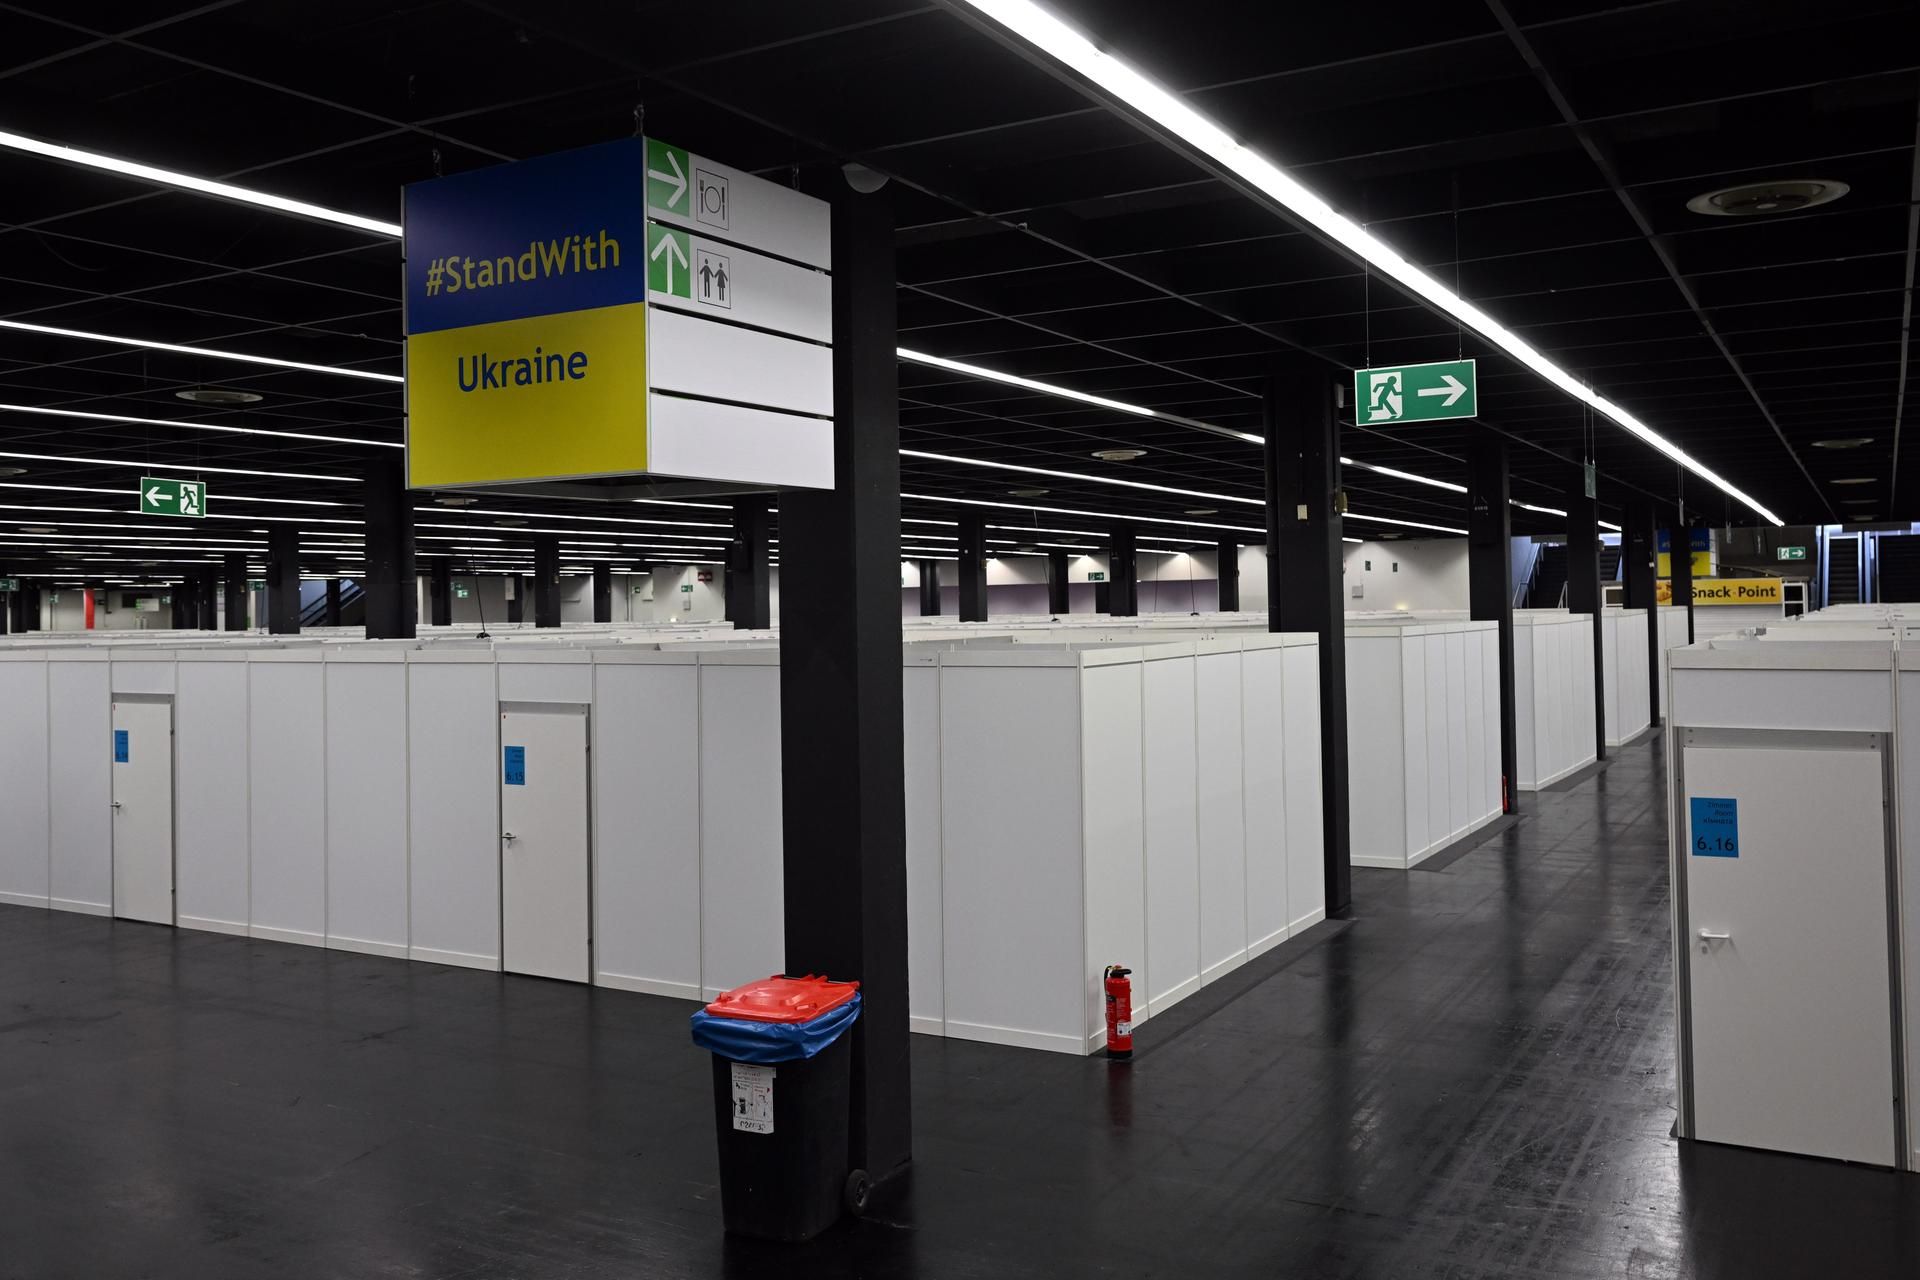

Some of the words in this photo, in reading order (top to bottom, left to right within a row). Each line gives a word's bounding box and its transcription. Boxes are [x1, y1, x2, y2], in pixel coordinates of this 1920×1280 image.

[426, 229, 620, 296] #StandWith
[458, 346, 588, 393] Ukraine
[1691, 585, 1731, 599] Snack
[1738, 585, 1776, 598] Point
[1697, 836, 1735, 851] 6.16
